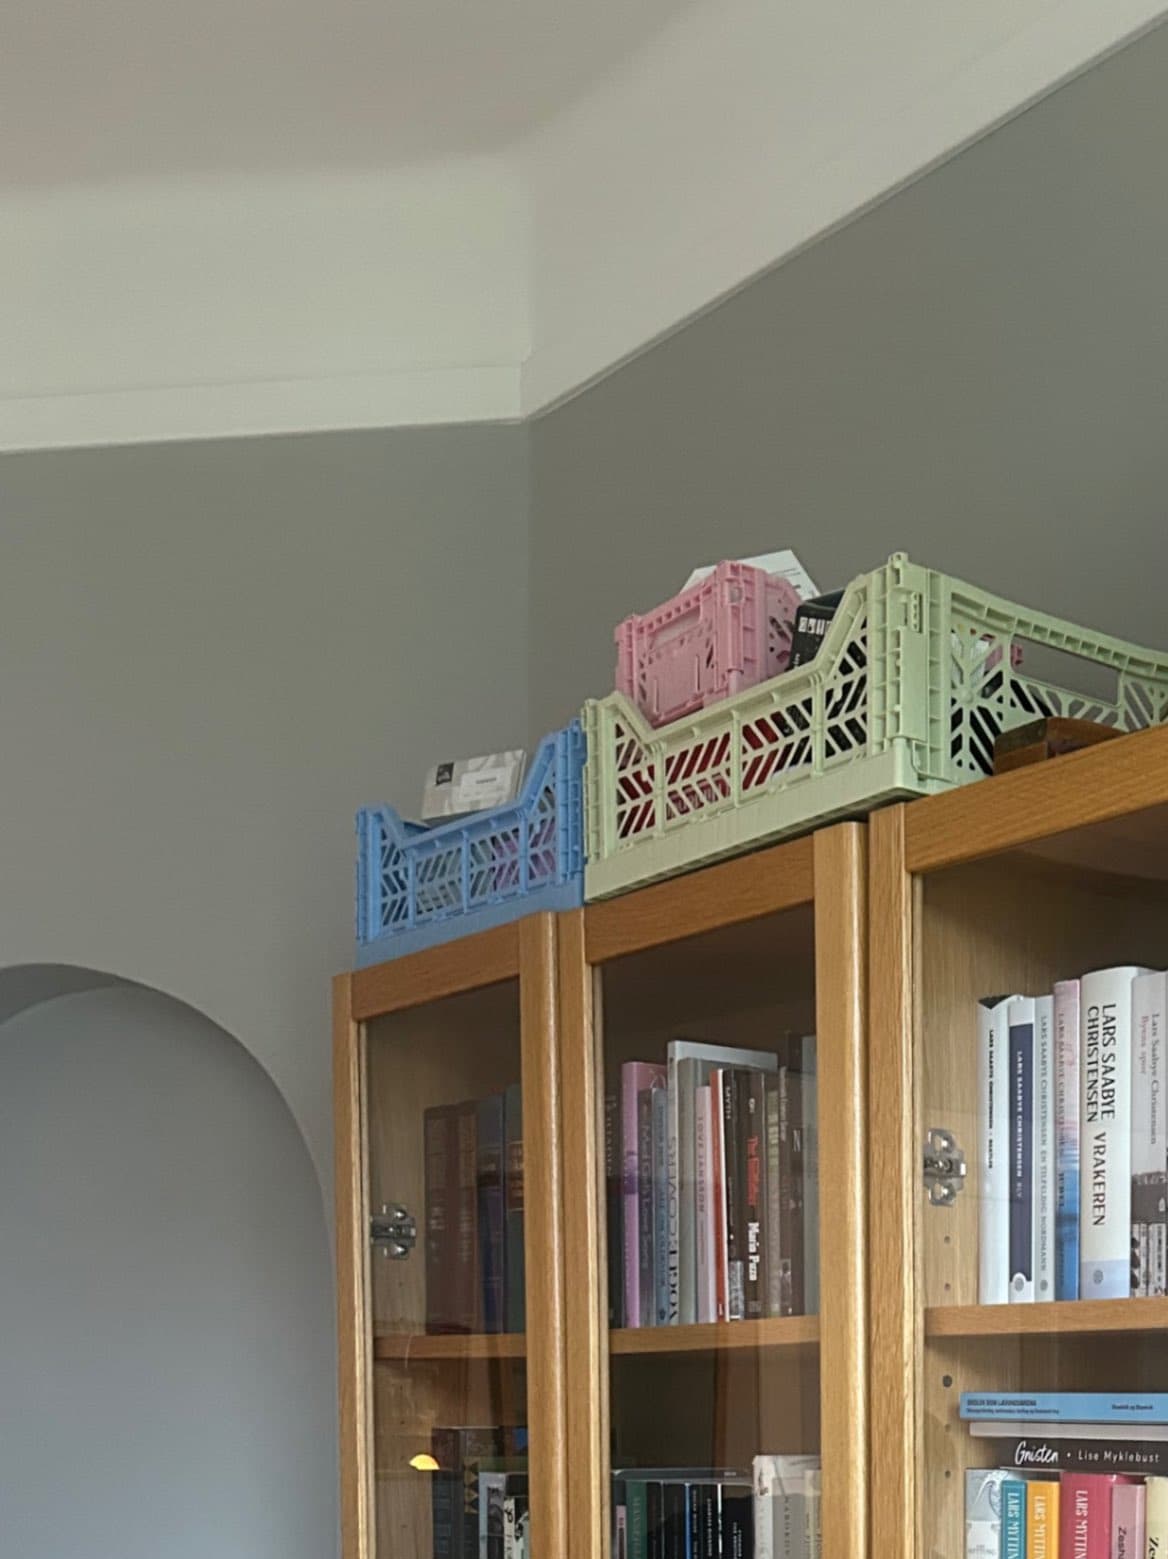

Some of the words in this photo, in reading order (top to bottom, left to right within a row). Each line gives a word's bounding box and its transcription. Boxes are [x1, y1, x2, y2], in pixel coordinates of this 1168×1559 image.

[1101, 1004, 1116, 1047] LARS
[1150, 1014, 1160, 1037] Lars
[1087, 1006, 1100, 1124] CHRISTENSEN
[1101, 1053, 1116, 1121] SAABYE
[1093, 1132, 1107, 1226] VRAKEREN
[1014, 1440, 1058, 1465] Gnisten
[1078, 1450, 1099, 1461] Lise
[1104, 1451, 1160, 1465] Myklebust
[1007, 1492, 1019, 1518] LARS
[1034, 1496, 1046, 1520] LARS
[1074, 1490, 1087, 1516] LARS
